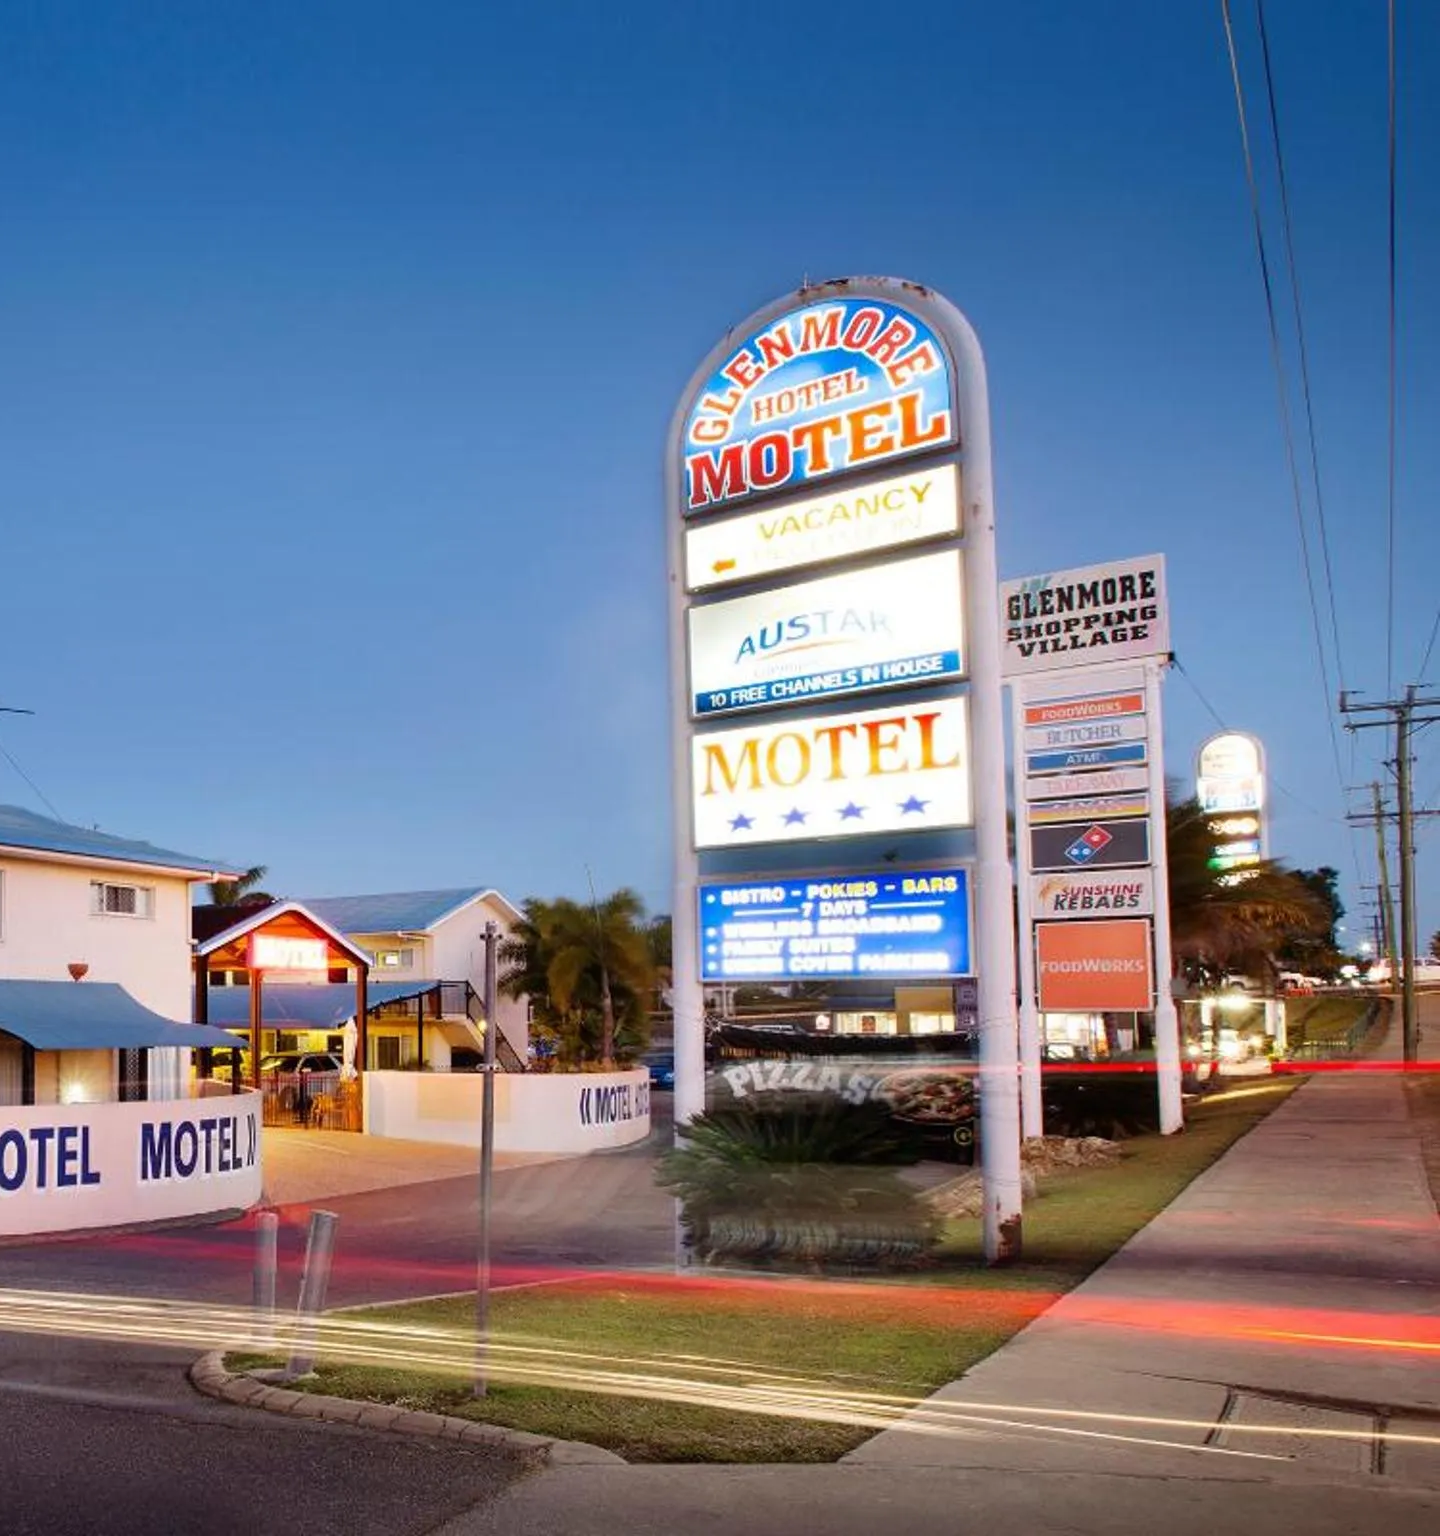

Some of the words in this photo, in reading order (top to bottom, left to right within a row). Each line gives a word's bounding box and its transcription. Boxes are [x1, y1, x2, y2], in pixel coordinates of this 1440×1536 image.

[691, 307, 940, 444] GLENMORE
[753, 370, 868, 424] HOTEL
[689, 393, 948, 507] MOTEL
[759, 481, 932, 540] VACANCY
[1007, 570, 1156, 621] GLENMORE
[1007, 605, 1157, 643] SHOPPING
[1017, 624, 1148, 657] VILLAGE
[710, 693, 726, 707] 10
[730, 686, 766, 706] FREE
[771, 669, 857, 696] CHANNELS
[862, 667, 879, 682] IN
[883, 656, 943, 678] HOUSE
[700, 712, 960, 796] MOTEL
[1047, 725, 1122, 745] BUTCHER
[721, 887, 785, 905] BISTRO
[807, 881, 878, 900] POKIES
[902, 877, 957, 896] BARS
[802, 903, 813, 918] 7
[820, 900, 867, 916] DAYS
[1054, 894, 1139, 911] KEBABS
[1062, 883, 1143, 897] SUNSHINE
[595, 1085, 631, 1124] MOTEL
[141, 1117, 243, 1180] MOTEL
